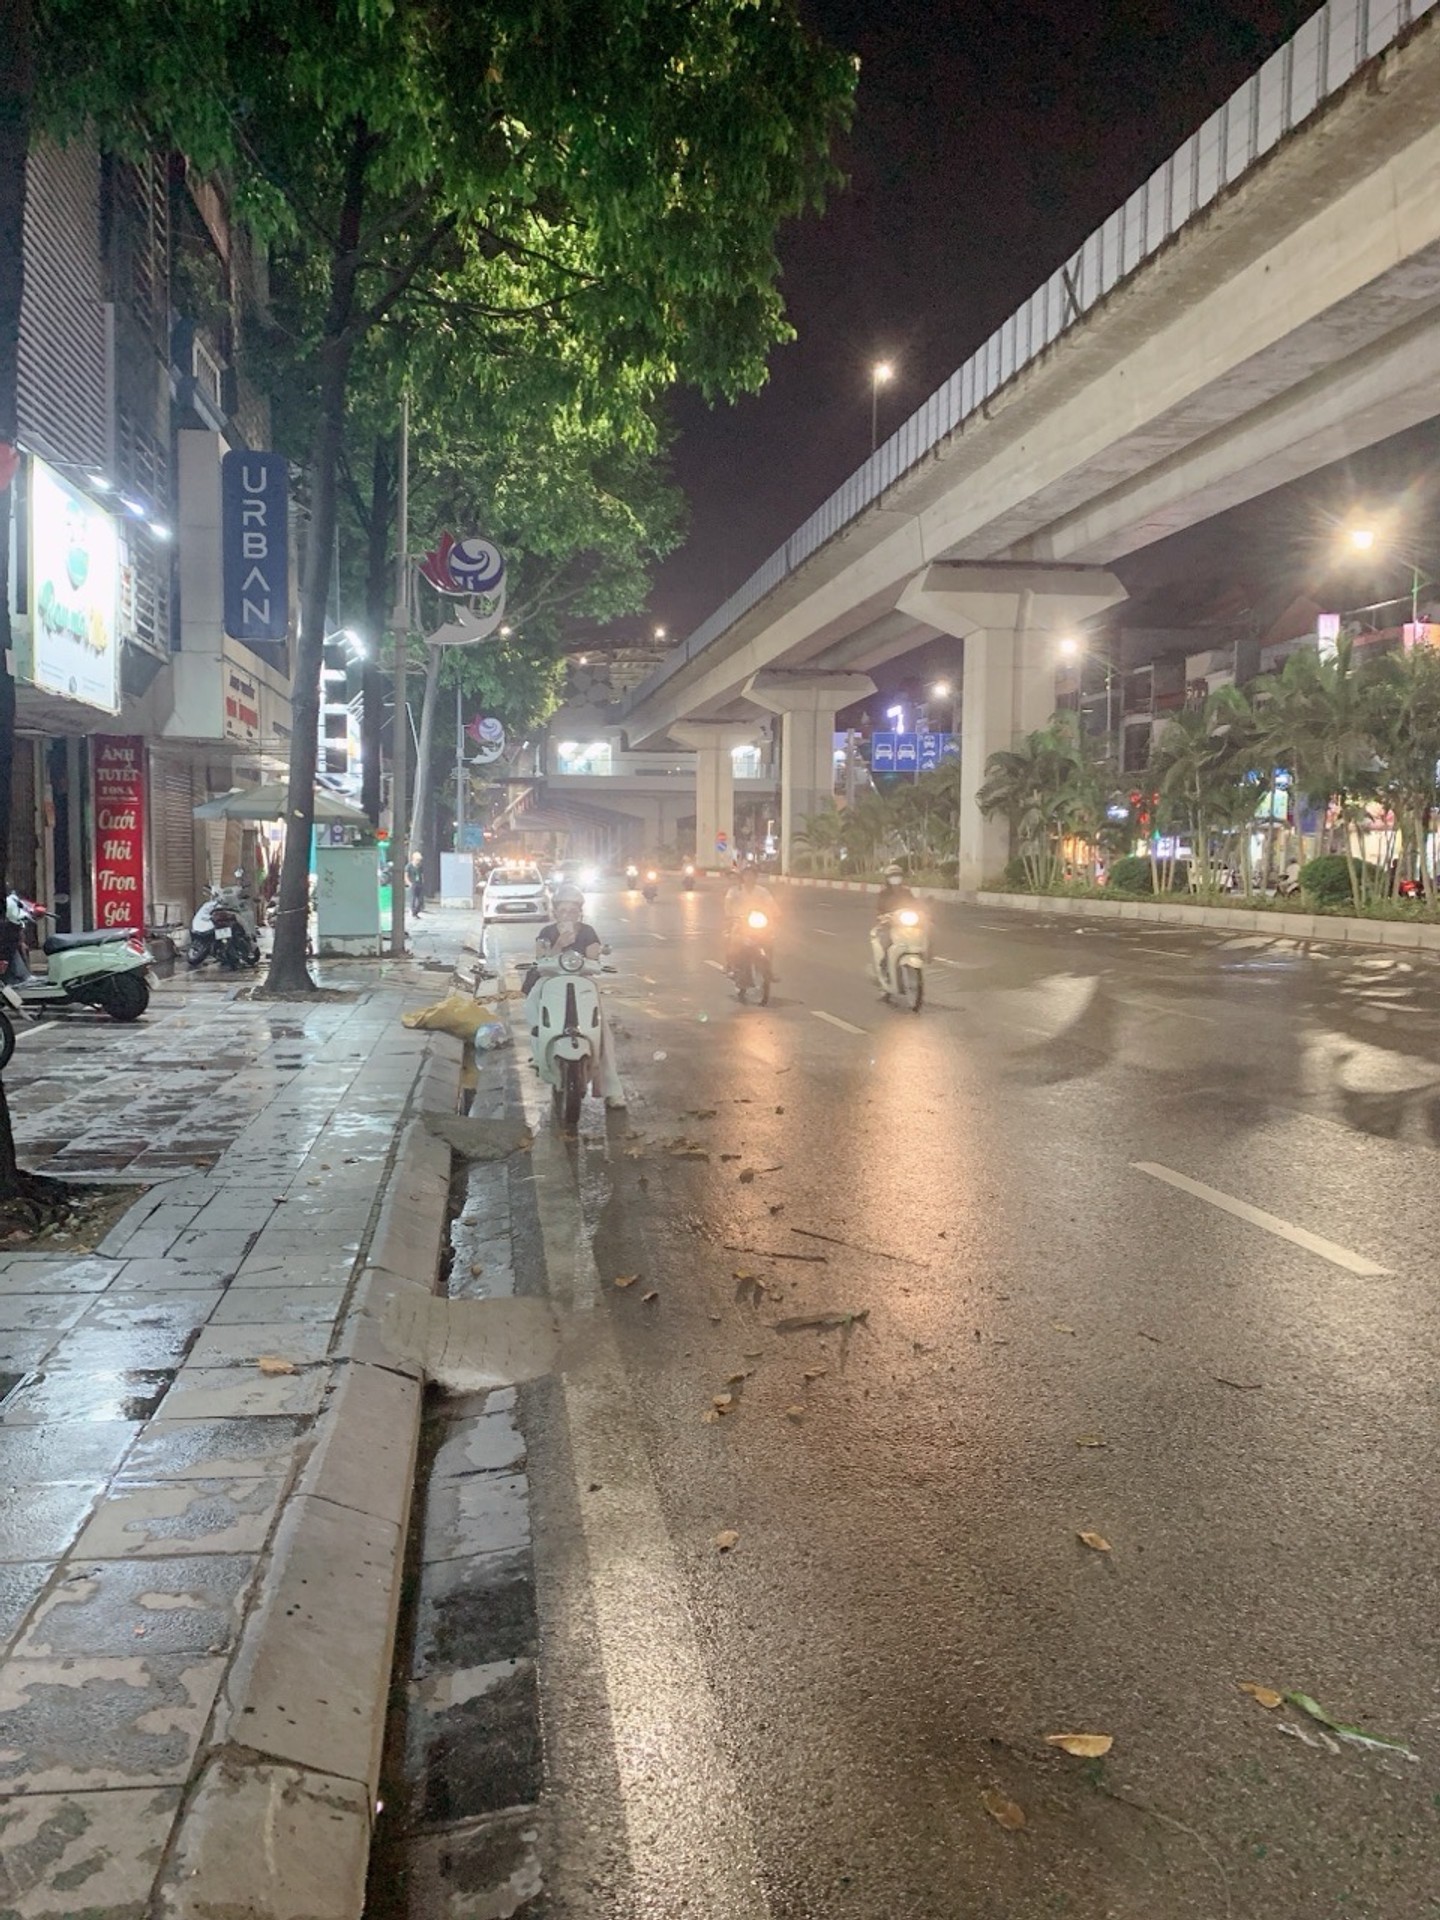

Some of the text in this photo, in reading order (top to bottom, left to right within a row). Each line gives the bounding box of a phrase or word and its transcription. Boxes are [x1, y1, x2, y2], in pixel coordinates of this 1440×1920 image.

[242, 465, 271, 625] URBAN
[99, 869, 137, 894] Trọn
[104, 900, 132, 926] Gói
